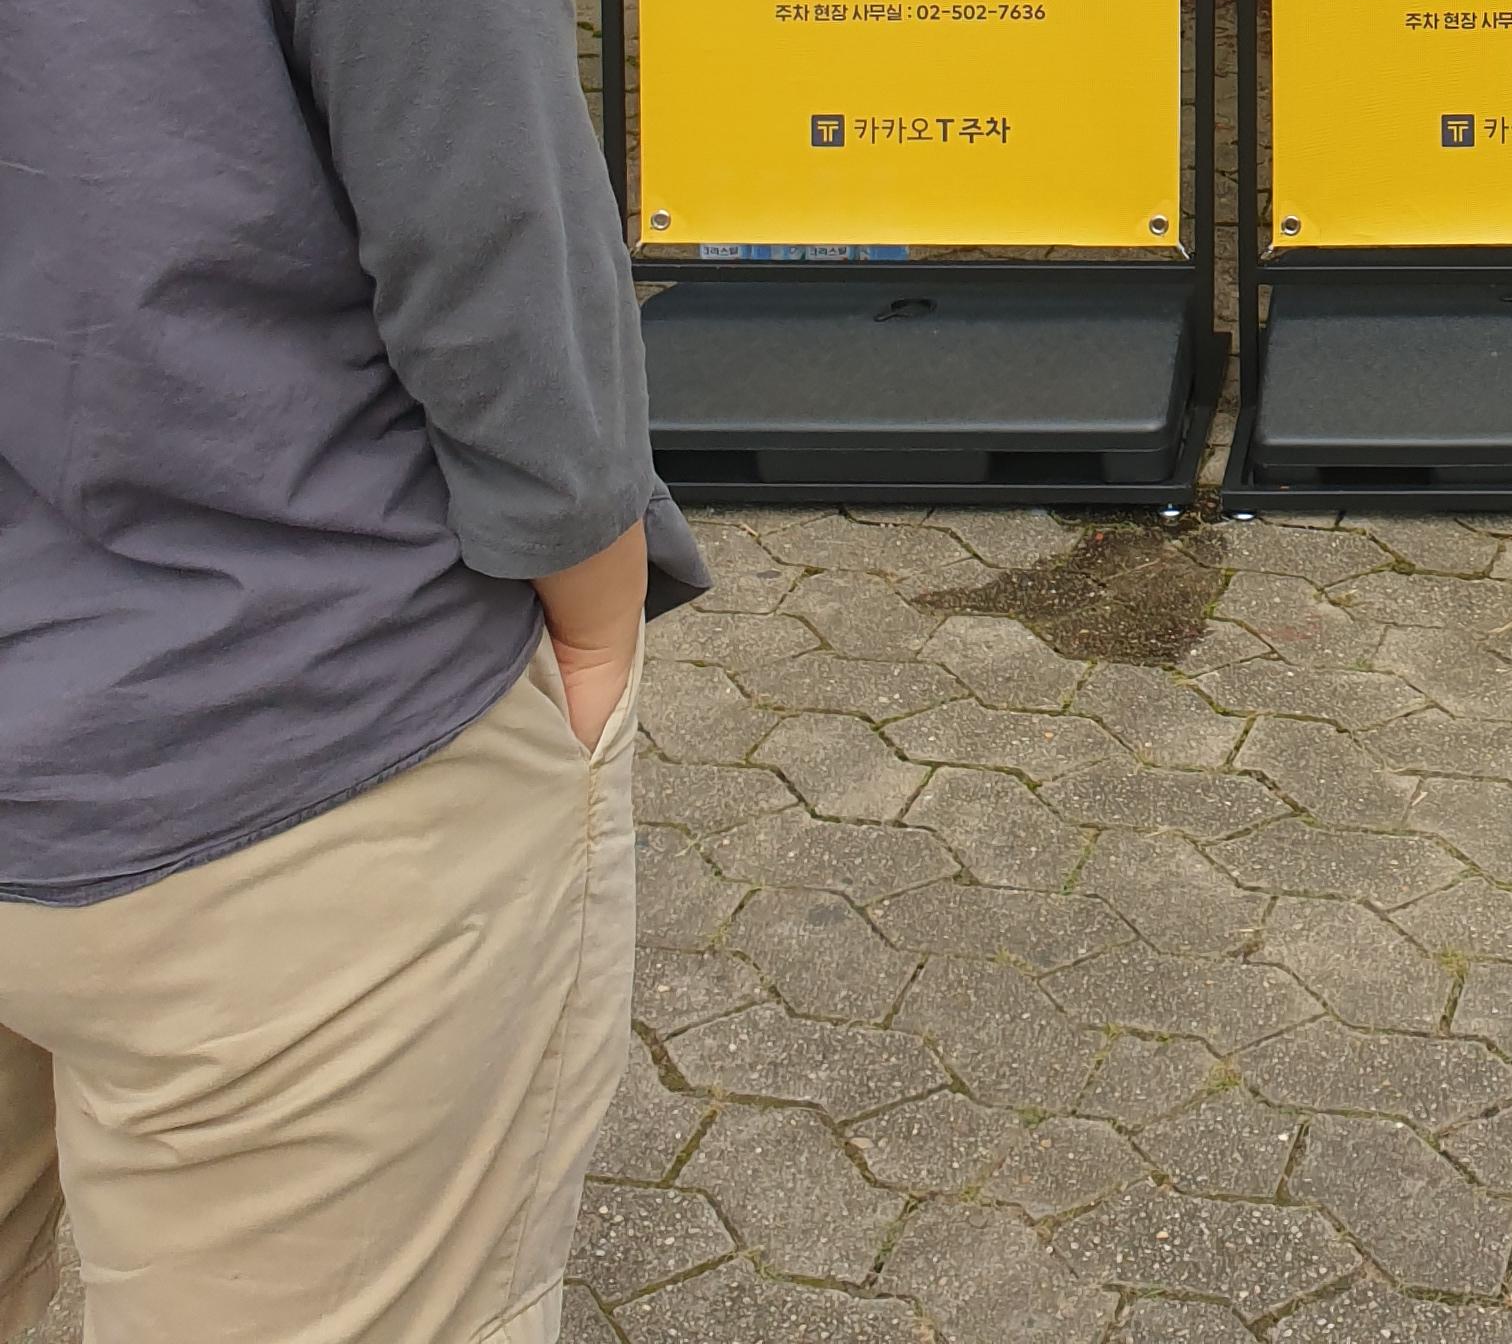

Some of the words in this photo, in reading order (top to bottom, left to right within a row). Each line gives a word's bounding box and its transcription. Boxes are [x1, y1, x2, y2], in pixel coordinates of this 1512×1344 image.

[775, 4, 809, 22] 주차
[814, 4, 848, 22] 현장
[852, 4, 903, 22] 사무실
[916, 5, 1046, 21] 02-502-7636
[1405, 12, 1440, 30] 주차
[1443, 12, 1477, 30] 현장
